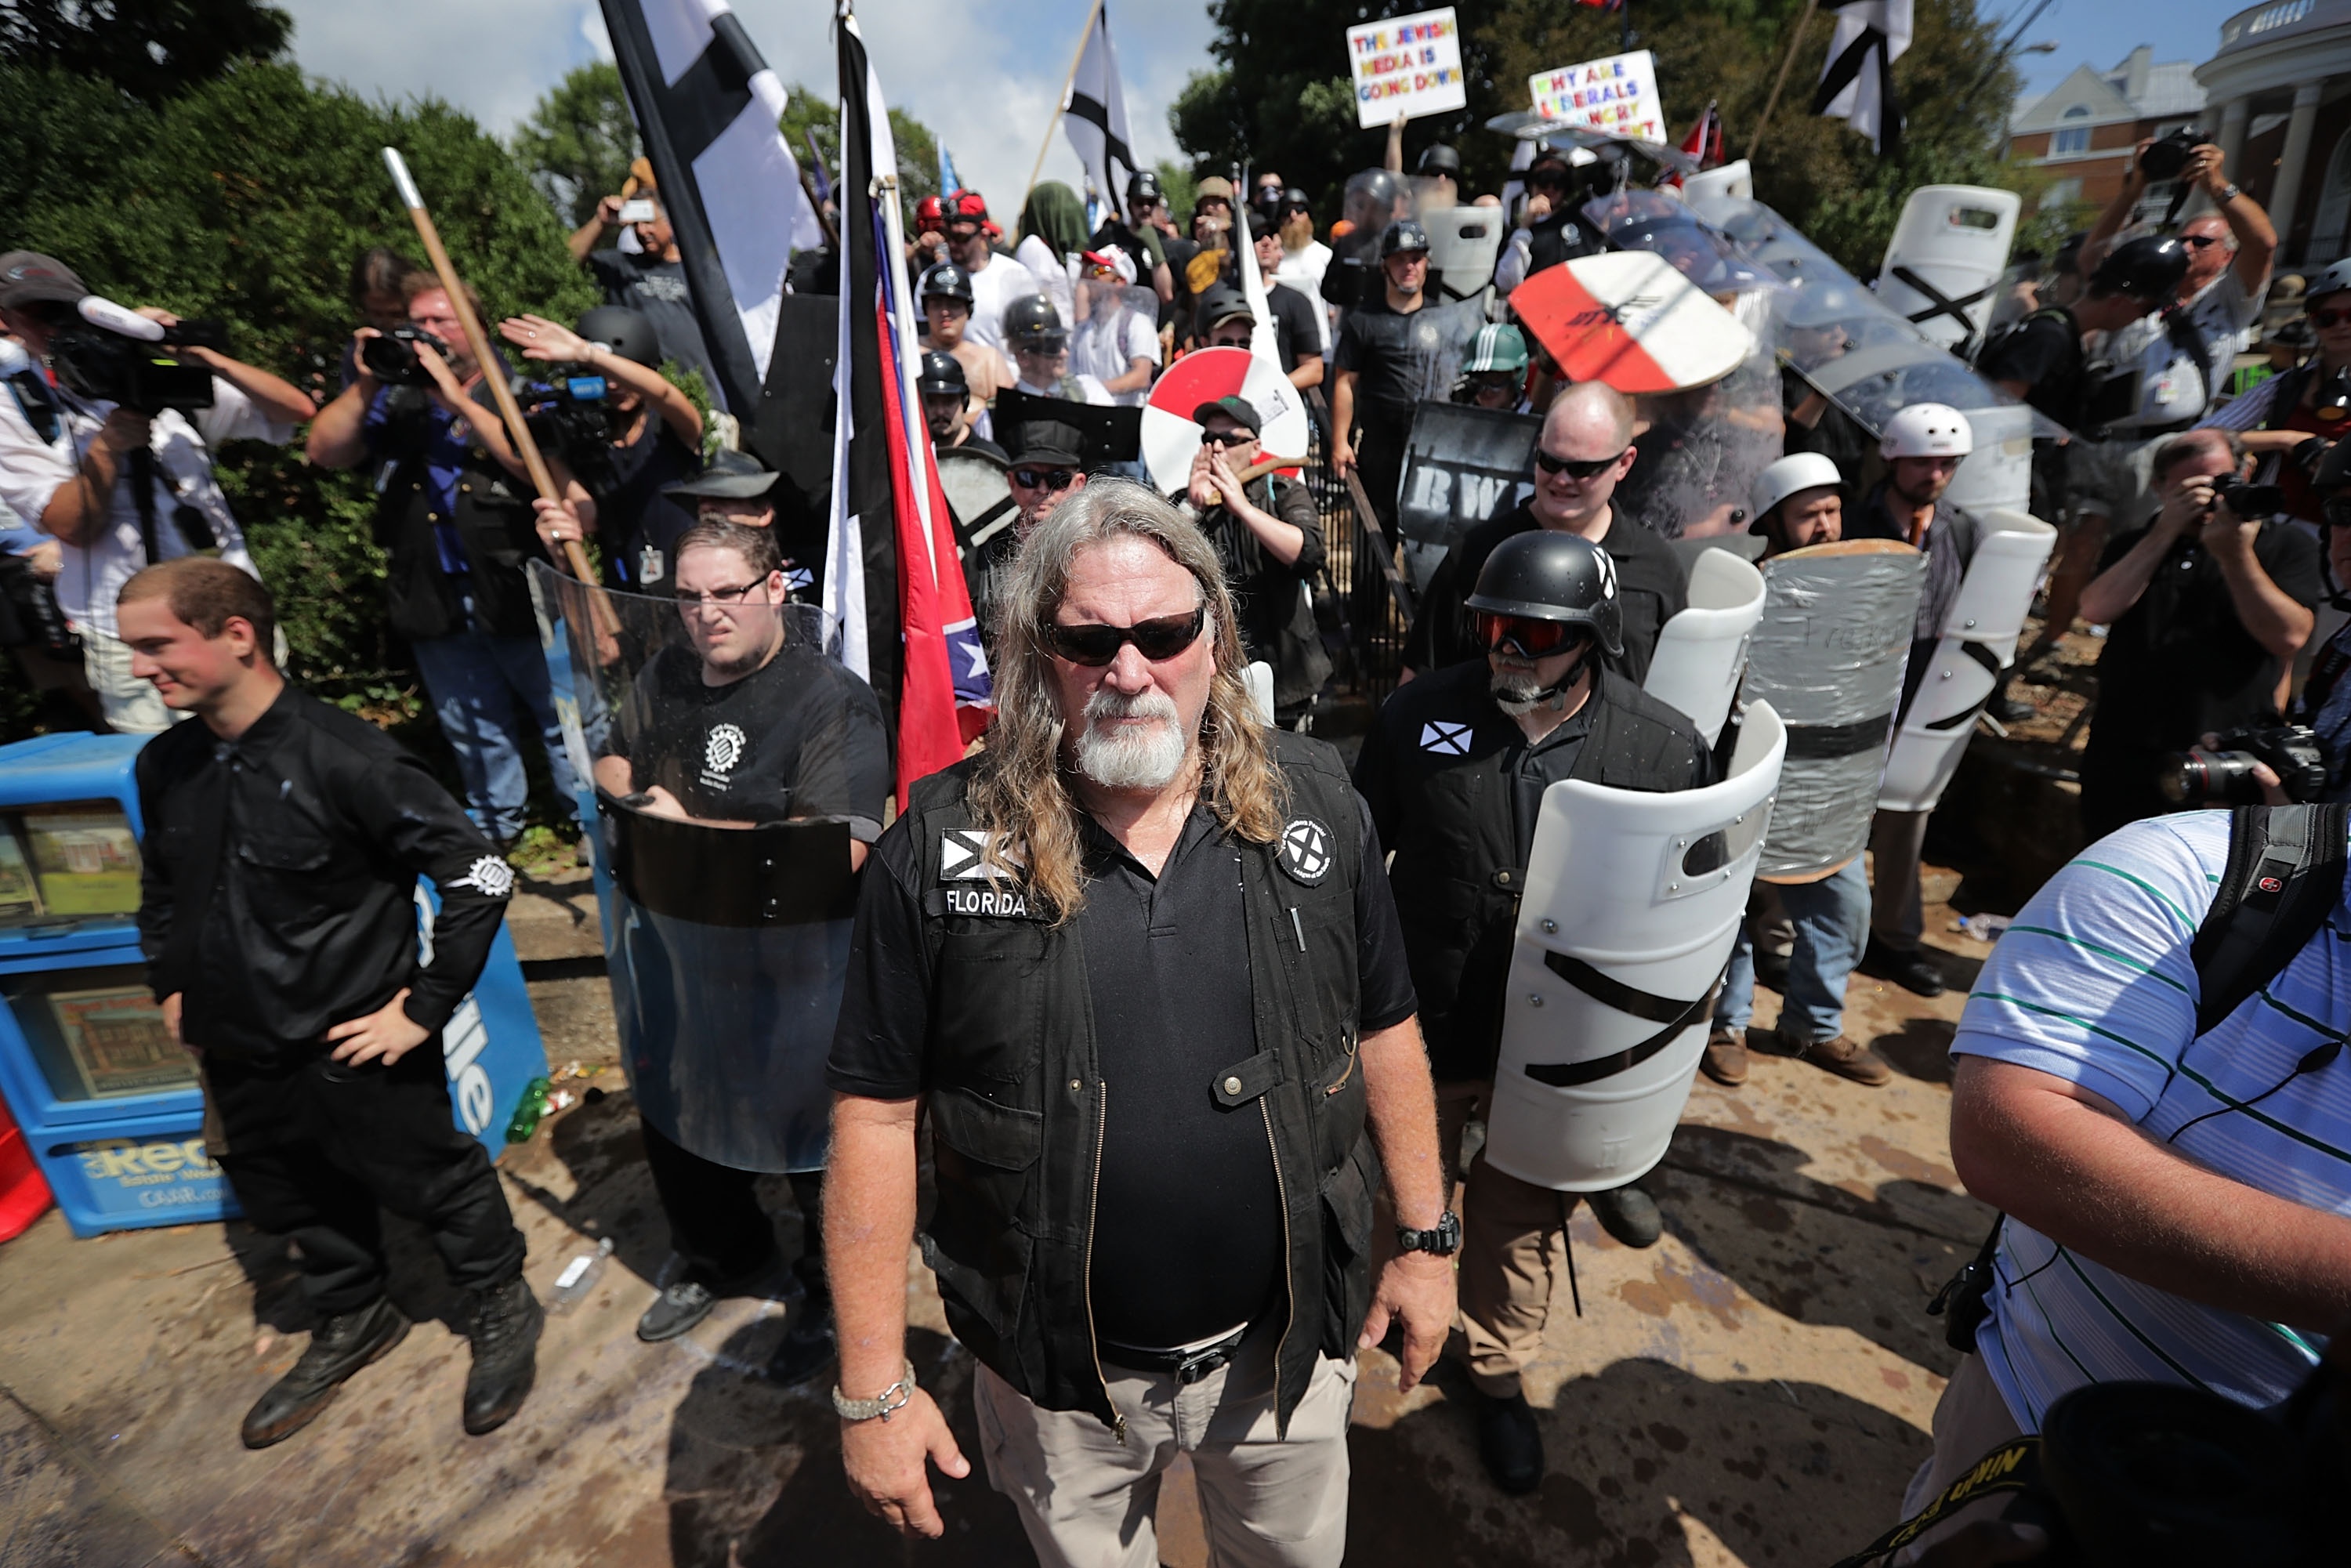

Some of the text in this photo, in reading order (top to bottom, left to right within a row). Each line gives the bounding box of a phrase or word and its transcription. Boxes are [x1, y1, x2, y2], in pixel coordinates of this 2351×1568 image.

[1353, 20, 1454, 53] THE JEWISH
[1360, 47, 1435, 76] MEDIA IS
[1360, 68, 1461, 100] GOING DOWN
[1535, 63, 1625, 93] WHY ARE
[1540, 80, 1638, 118] LIBERALS
[946, 890, 1027, 916] FLORIDA
